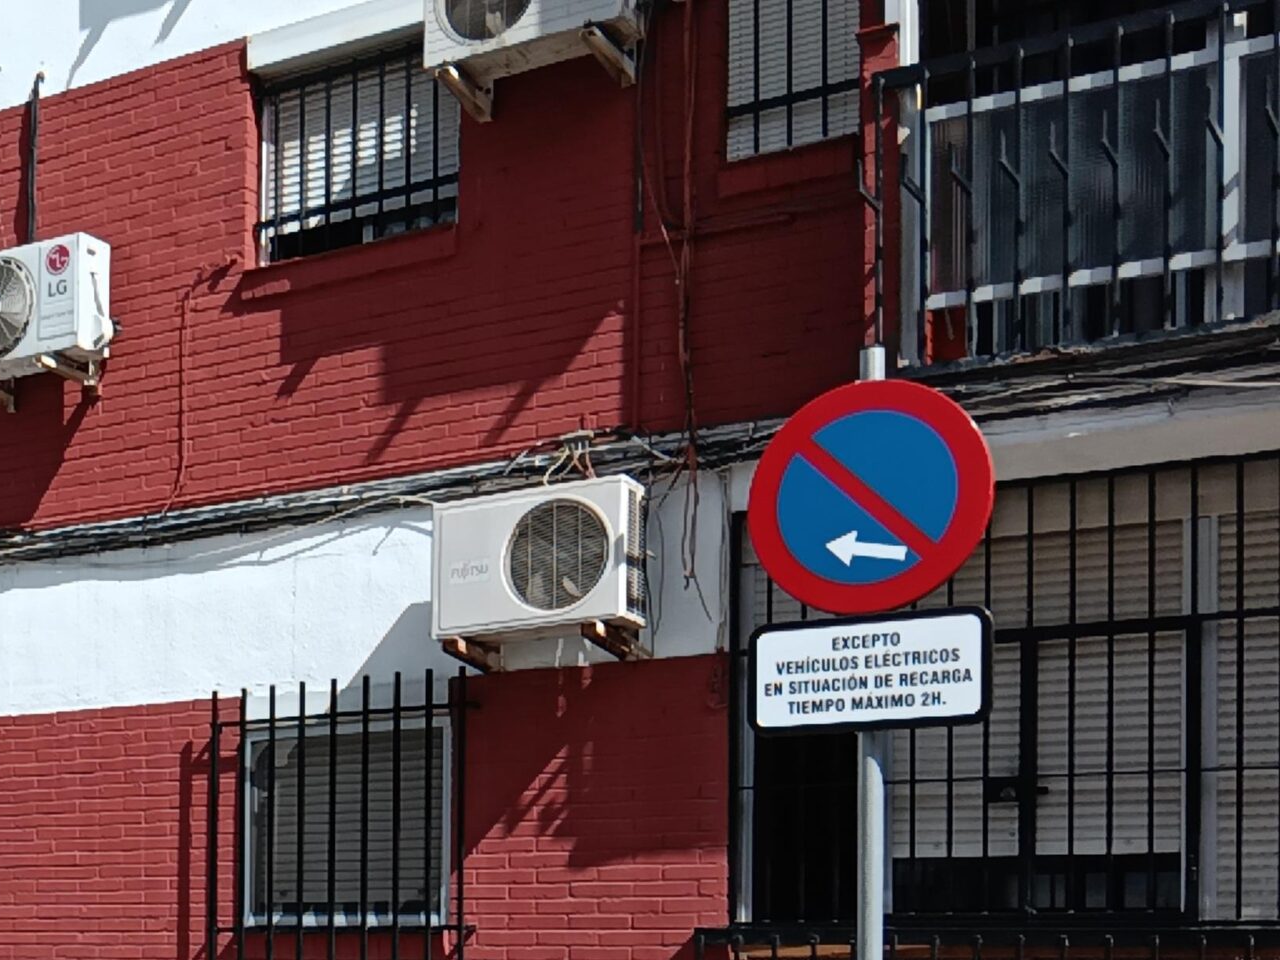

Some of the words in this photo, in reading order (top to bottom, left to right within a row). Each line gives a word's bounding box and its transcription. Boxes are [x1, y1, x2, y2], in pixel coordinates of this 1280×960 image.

[48, 280, 67, 297] LG
[831, 632, 901, 651] EXCEPTO
[776, 655, 859, 676] VEHÍCULOS
[864, 647, 961, 669] ELÉCTRICOS
[764, 682, 783, 697] EN
[788, 673, 869, 695] SITUACIÓN
[874, 673, 893, 688] DE
[899, 668, 973, 687] RECARGA
[788, 697, 846, 715] TIEMPO
[851, 691, 916, 711] MÁXIMO
[920, 691, 947, 707] 2H.
